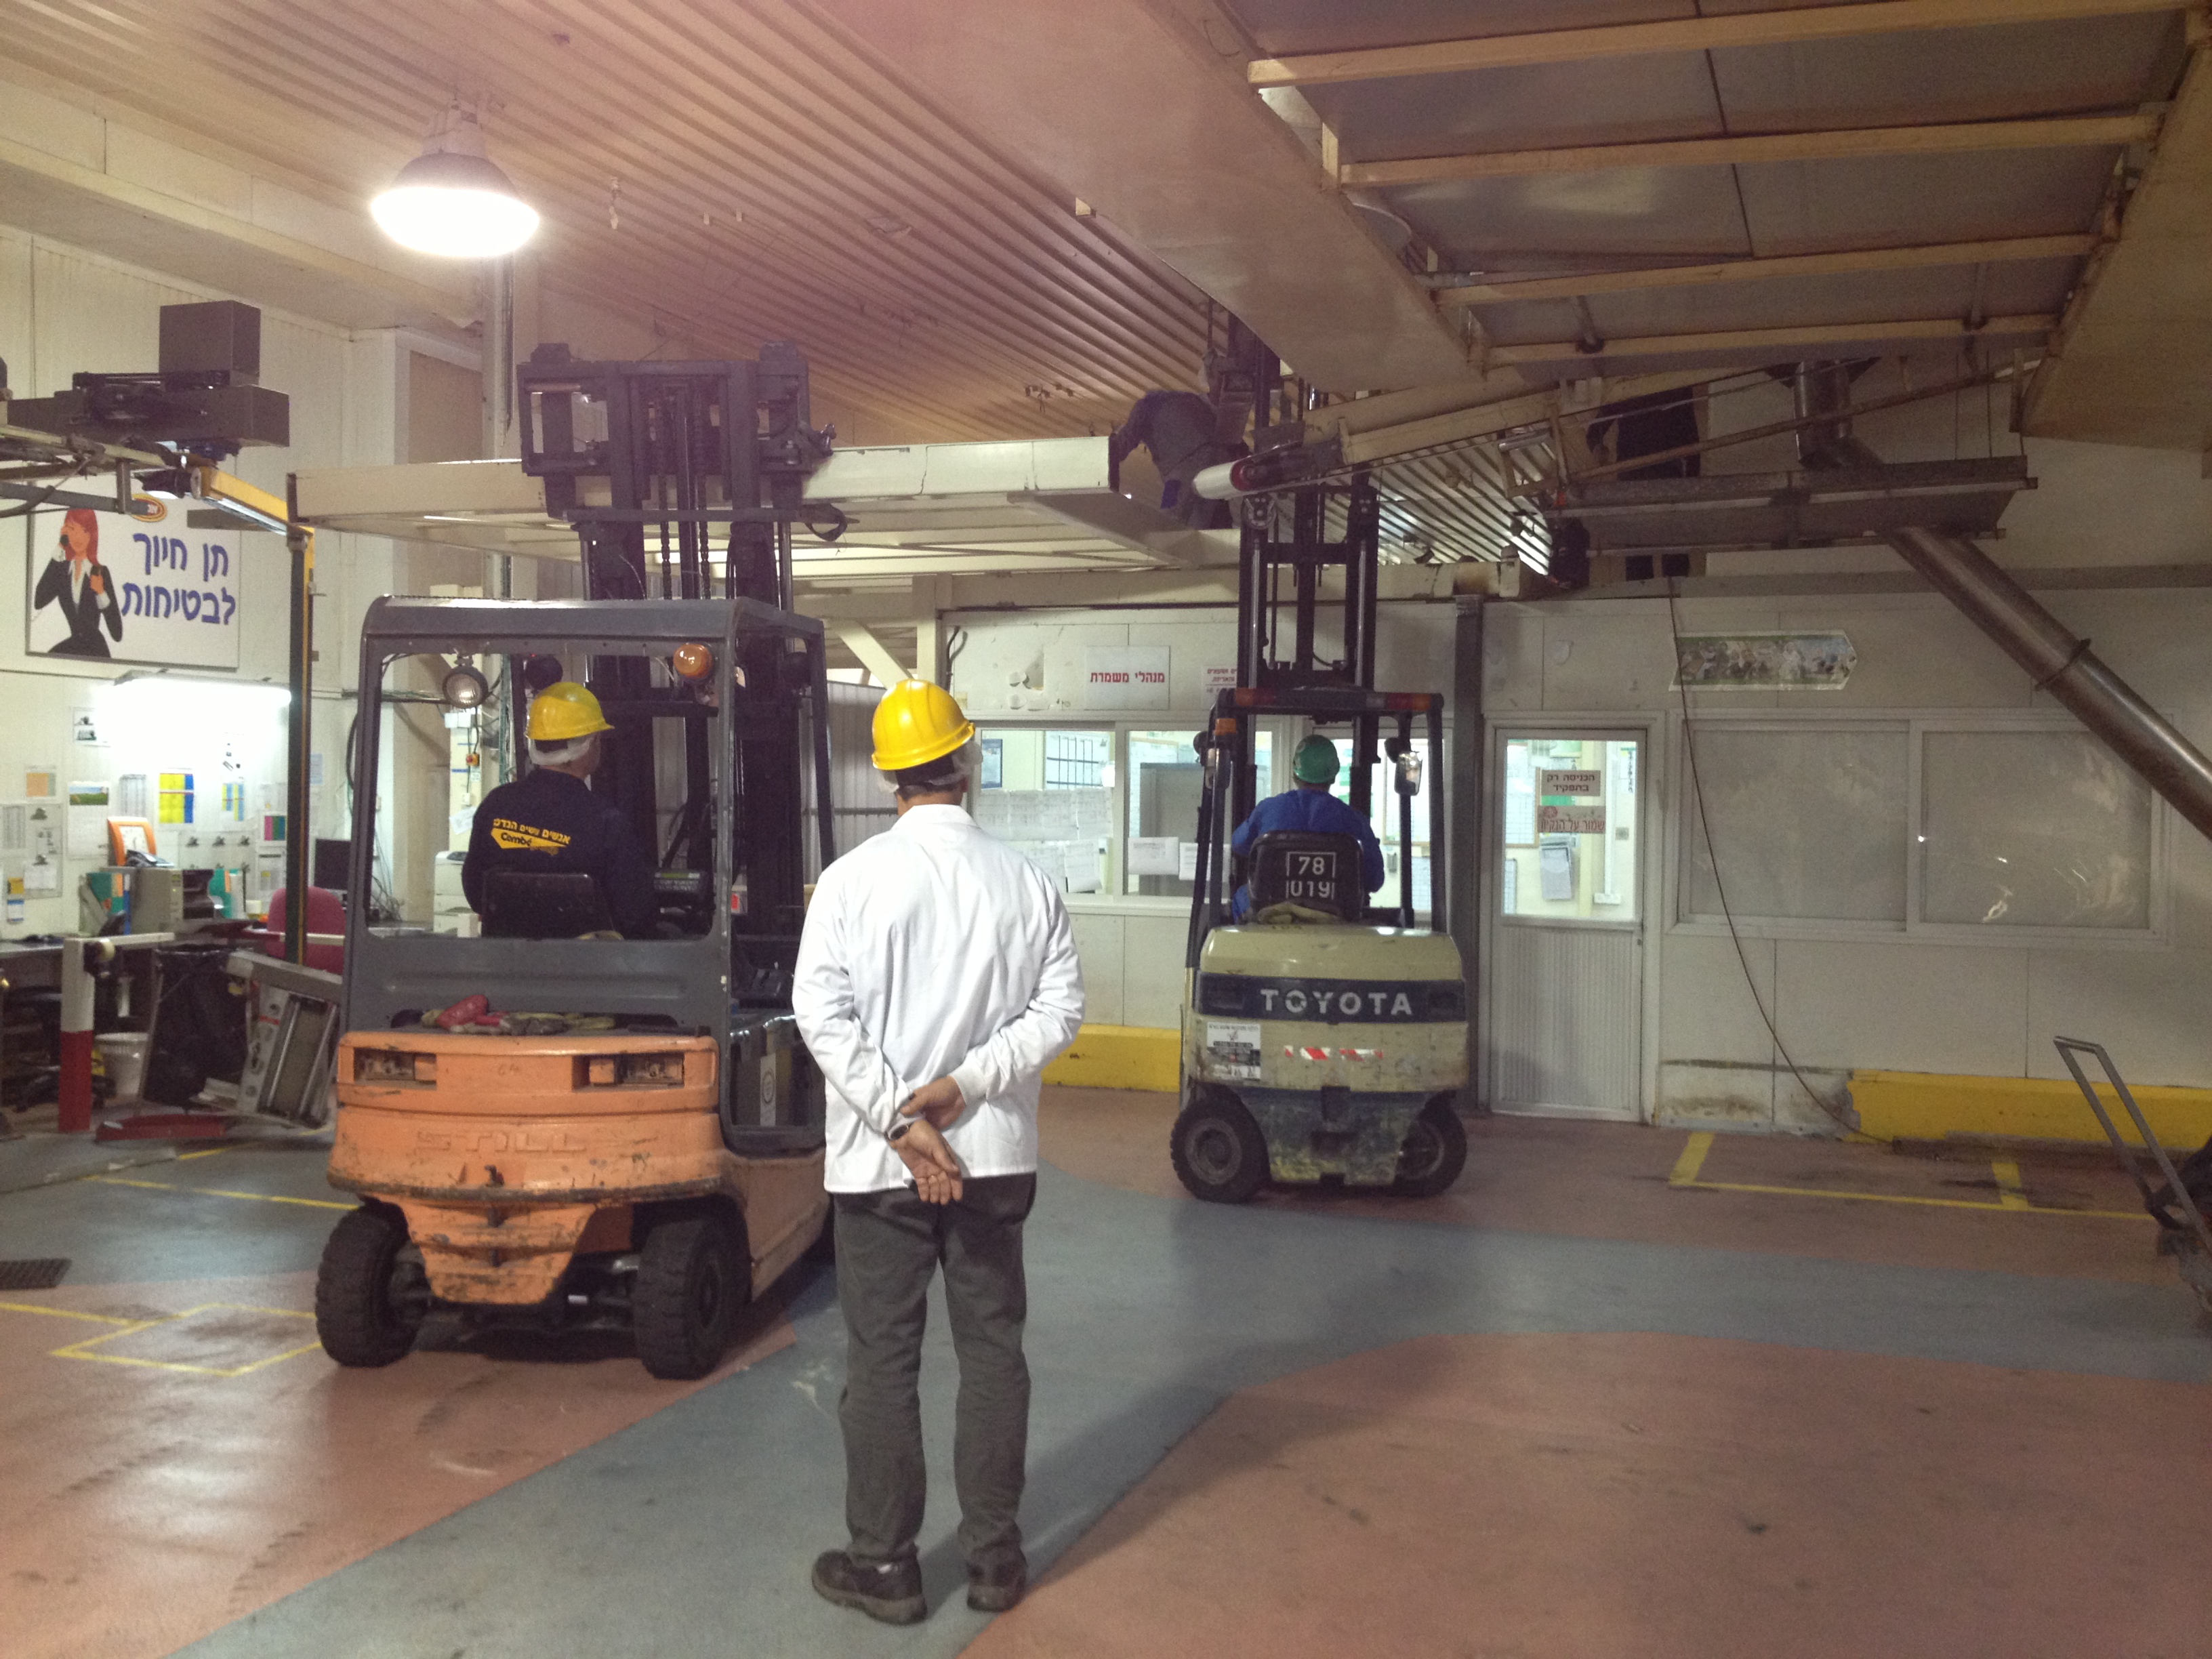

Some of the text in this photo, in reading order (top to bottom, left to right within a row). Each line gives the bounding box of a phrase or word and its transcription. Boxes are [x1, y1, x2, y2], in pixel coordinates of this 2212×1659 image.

[133, 533, 228, 582] תן חיוך
[121, 582, 236, 626] לבטיחות
[1090, 671, 1166, 683] מנהלי משמרת
[1547, 774, 1559, 783] רק
[541, 829, 571, 844] אנשים
[1298, 856, 1325, 876] 78
[1260, 989, 1412, 1016] TOYOTA
